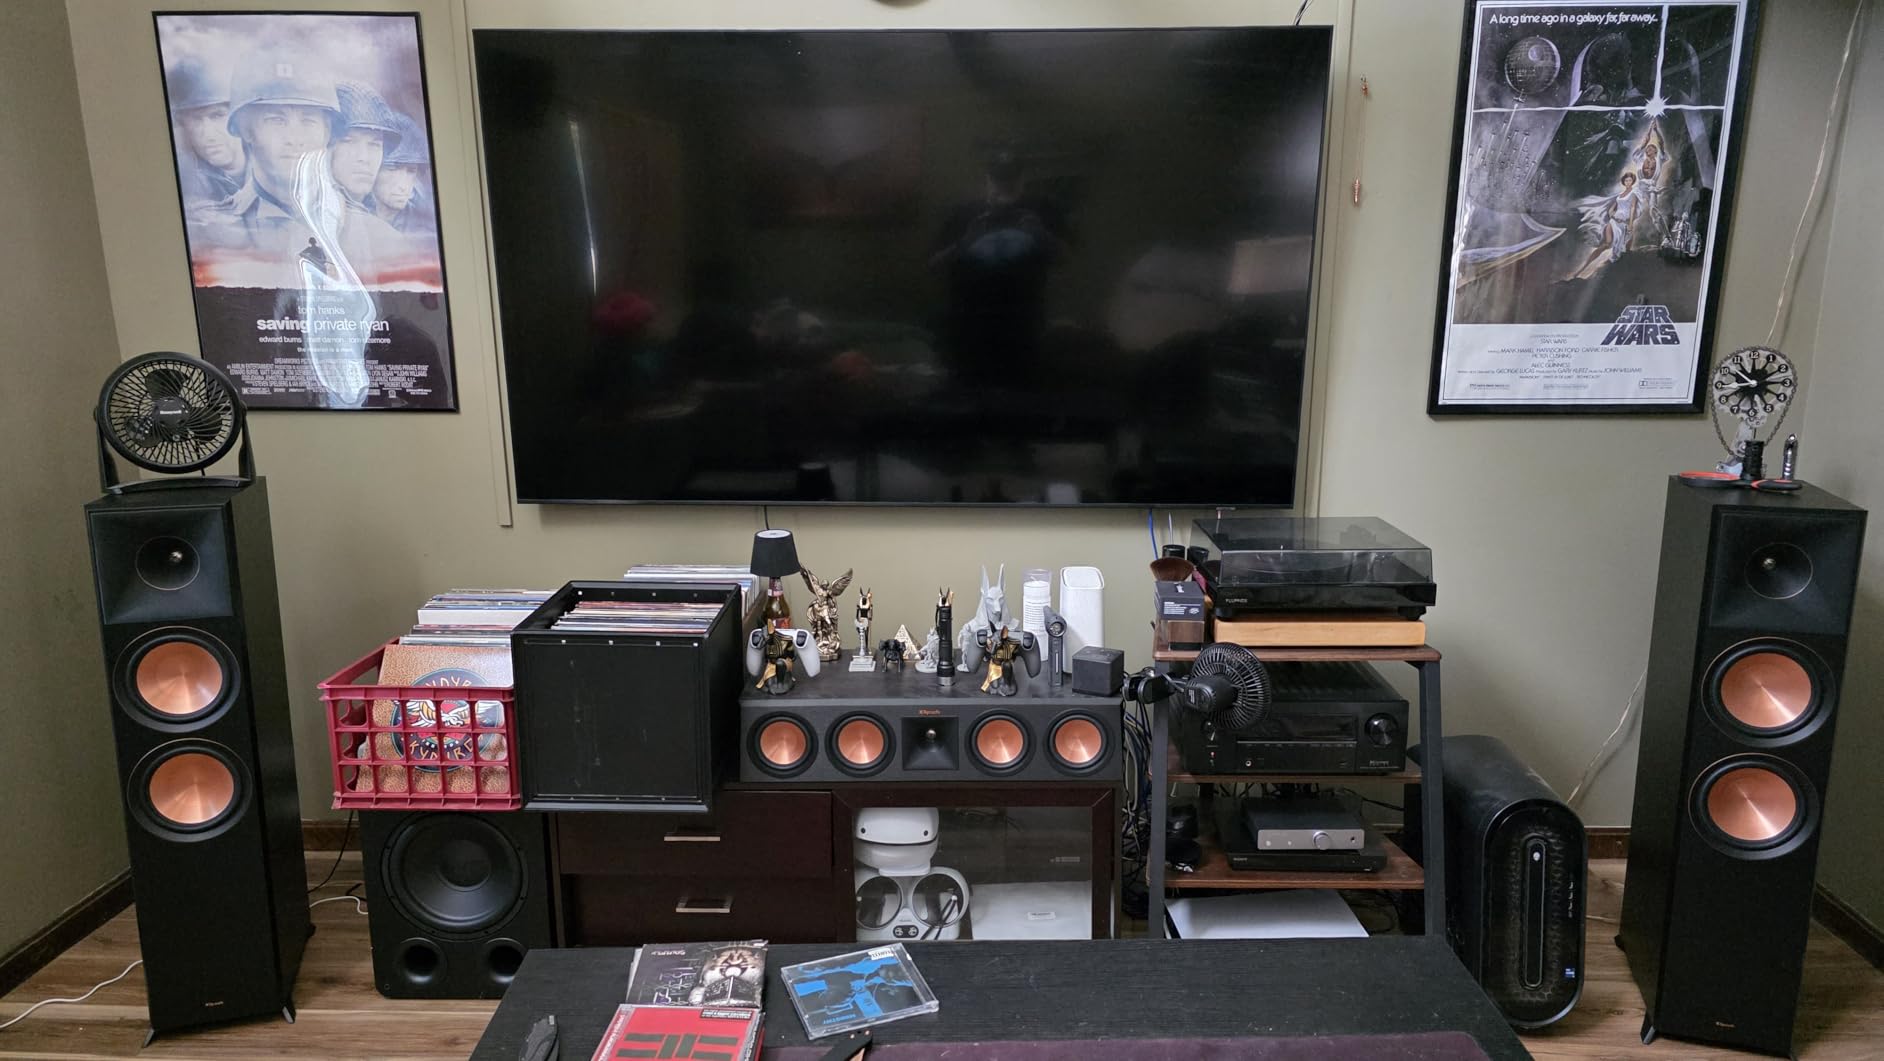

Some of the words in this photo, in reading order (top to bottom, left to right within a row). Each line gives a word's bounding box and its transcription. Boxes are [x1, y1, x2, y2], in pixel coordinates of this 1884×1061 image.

[1489, 14, 1498, 24] A
[1499, 13, 1519, 26] long
[1520, 13, 1540, 23] time
[1541, 15, 1559, 26] ago
[1560, 13, 1568, 23] in
[1569, 14, 1575, 23] a
[1576, 12, 1605, 25] galaxy
[1617, 12, 1630, 25] far
[318, 305, 345, 315] hanks
[1615, 305, 1673, 324] STAR
[257, 316, 309, 333] saving
[314, 317, 357, 333] private
[361, 319, 390, 335] ryan
[259, 335, 282, 343] edward
[284, 335, 302, 343] burns
[1600, 323, 1680, 346] WARS
[1721, 367, 1729, 375] 10
